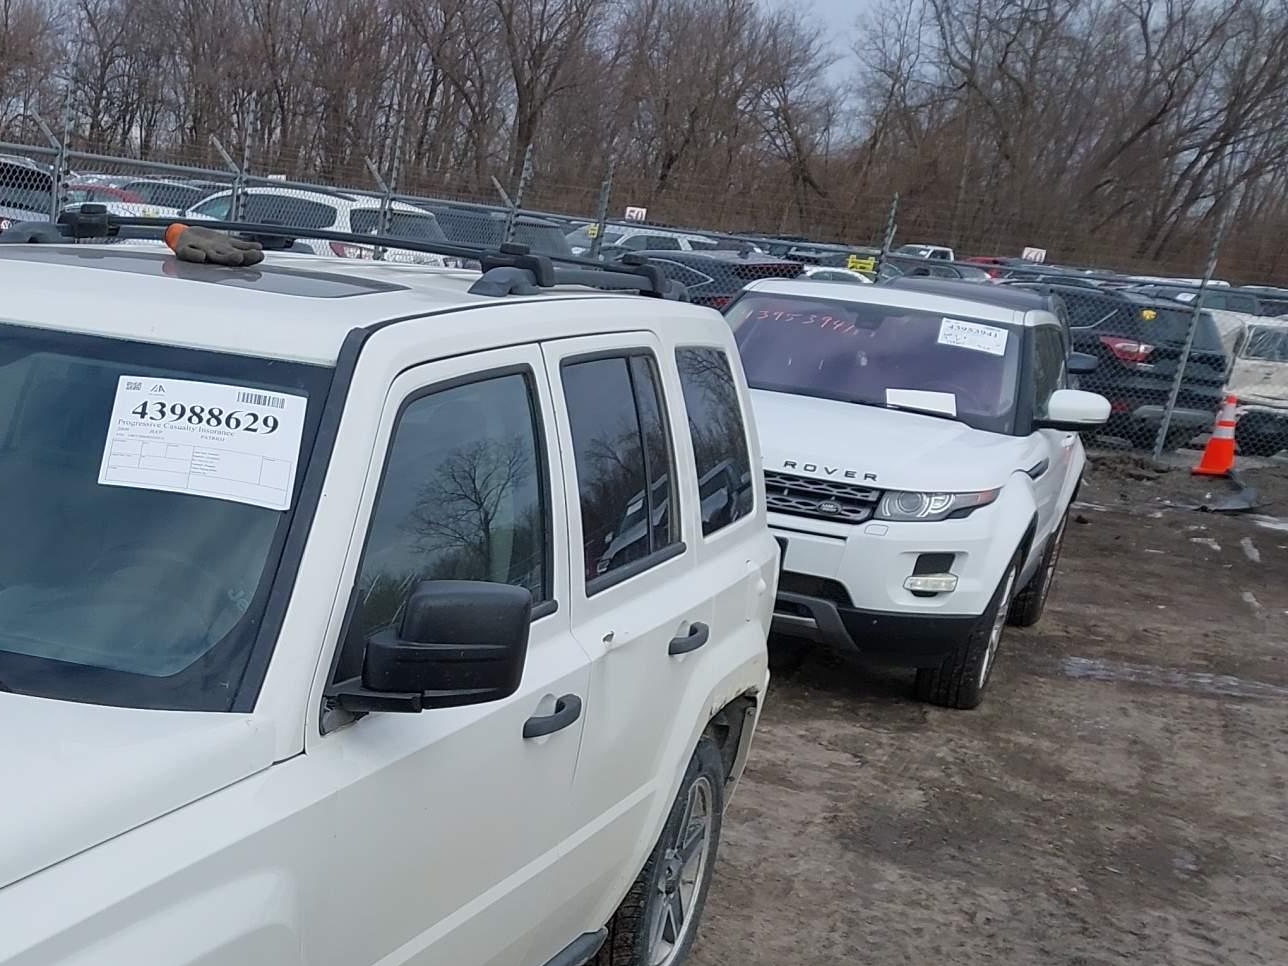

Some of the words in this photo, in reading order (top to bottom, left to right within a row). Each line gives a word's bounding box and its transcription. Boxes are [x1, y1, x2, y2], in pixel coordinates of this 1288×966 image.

[626, 208, 645, 221] 50
[131, 400, 280, 435] 43988629
[117, 419, 162, 429] Progressive
[163, 422, 197, 432] Casualty
[198, 426, 233, 436] Insurance
[783, 460, 878, 482] ROVER
